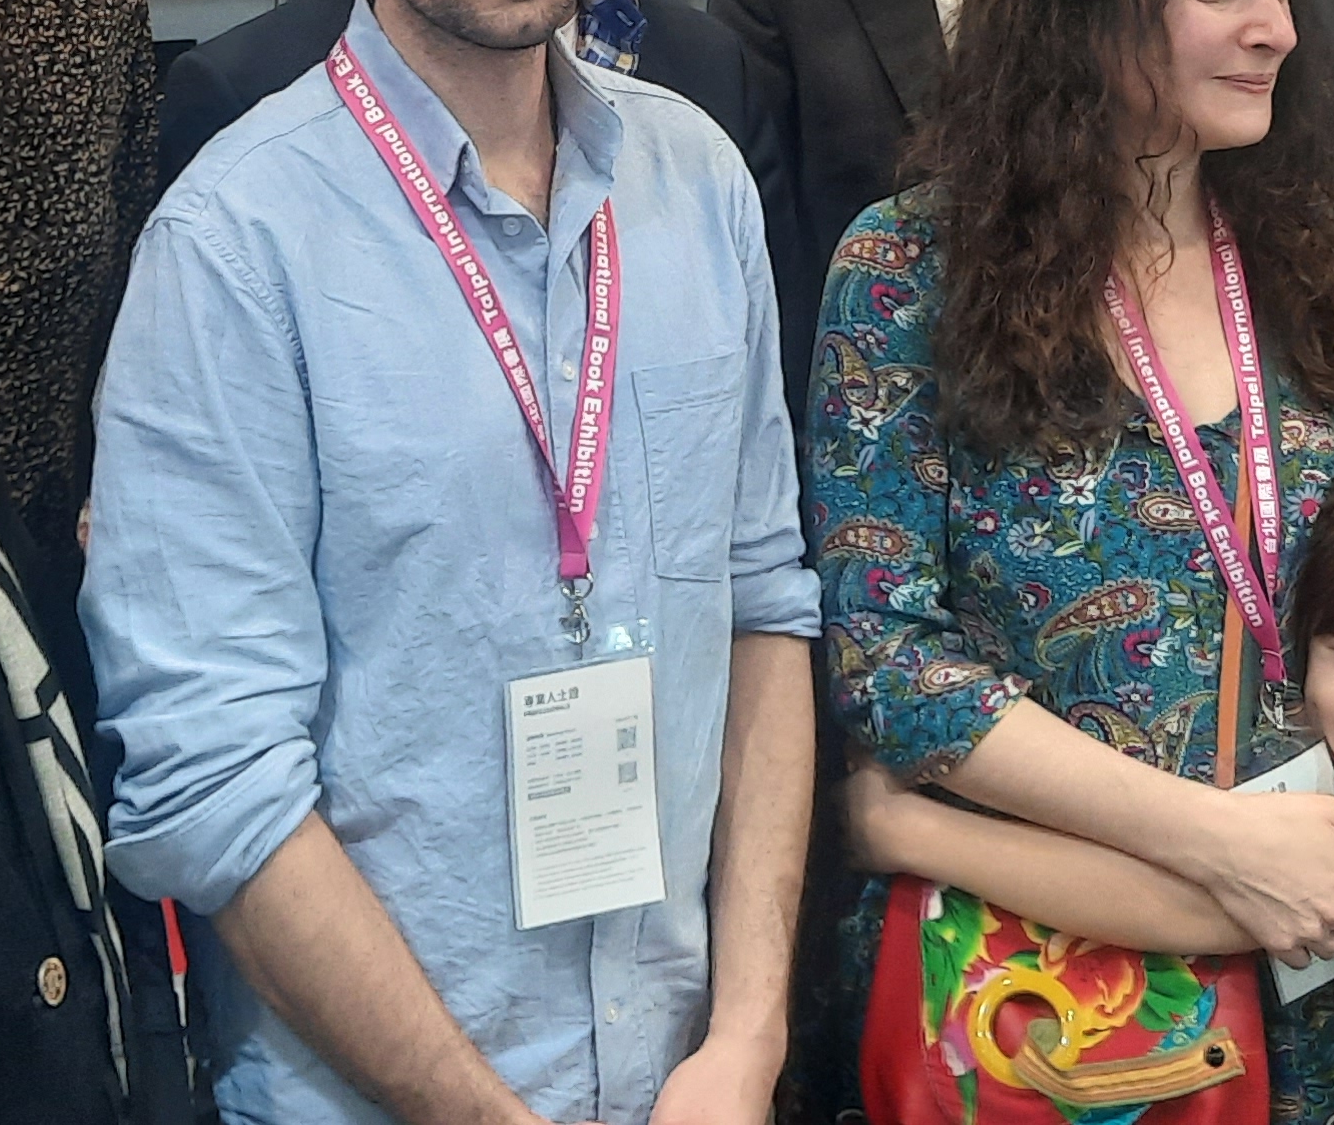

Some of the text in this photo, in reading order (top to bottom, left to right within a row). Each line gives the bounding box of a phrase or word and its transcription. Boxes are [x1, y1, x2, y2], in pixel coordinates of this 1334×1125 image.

[345, 72, 386, 125] Book
[373, 122, 467, 256] International
[455, 254, 500, 325] Taipei
[1216, 244, 1257, 373] International
[569, 203, 613, 514] ternational Book Exhibition
[1241, 375, 1267, 440] Taipei
[1127, 336, 1197, 470] International
[1188, 469, 1223, 524] Book
[1210, 523, 1264, 629] Exhibition
